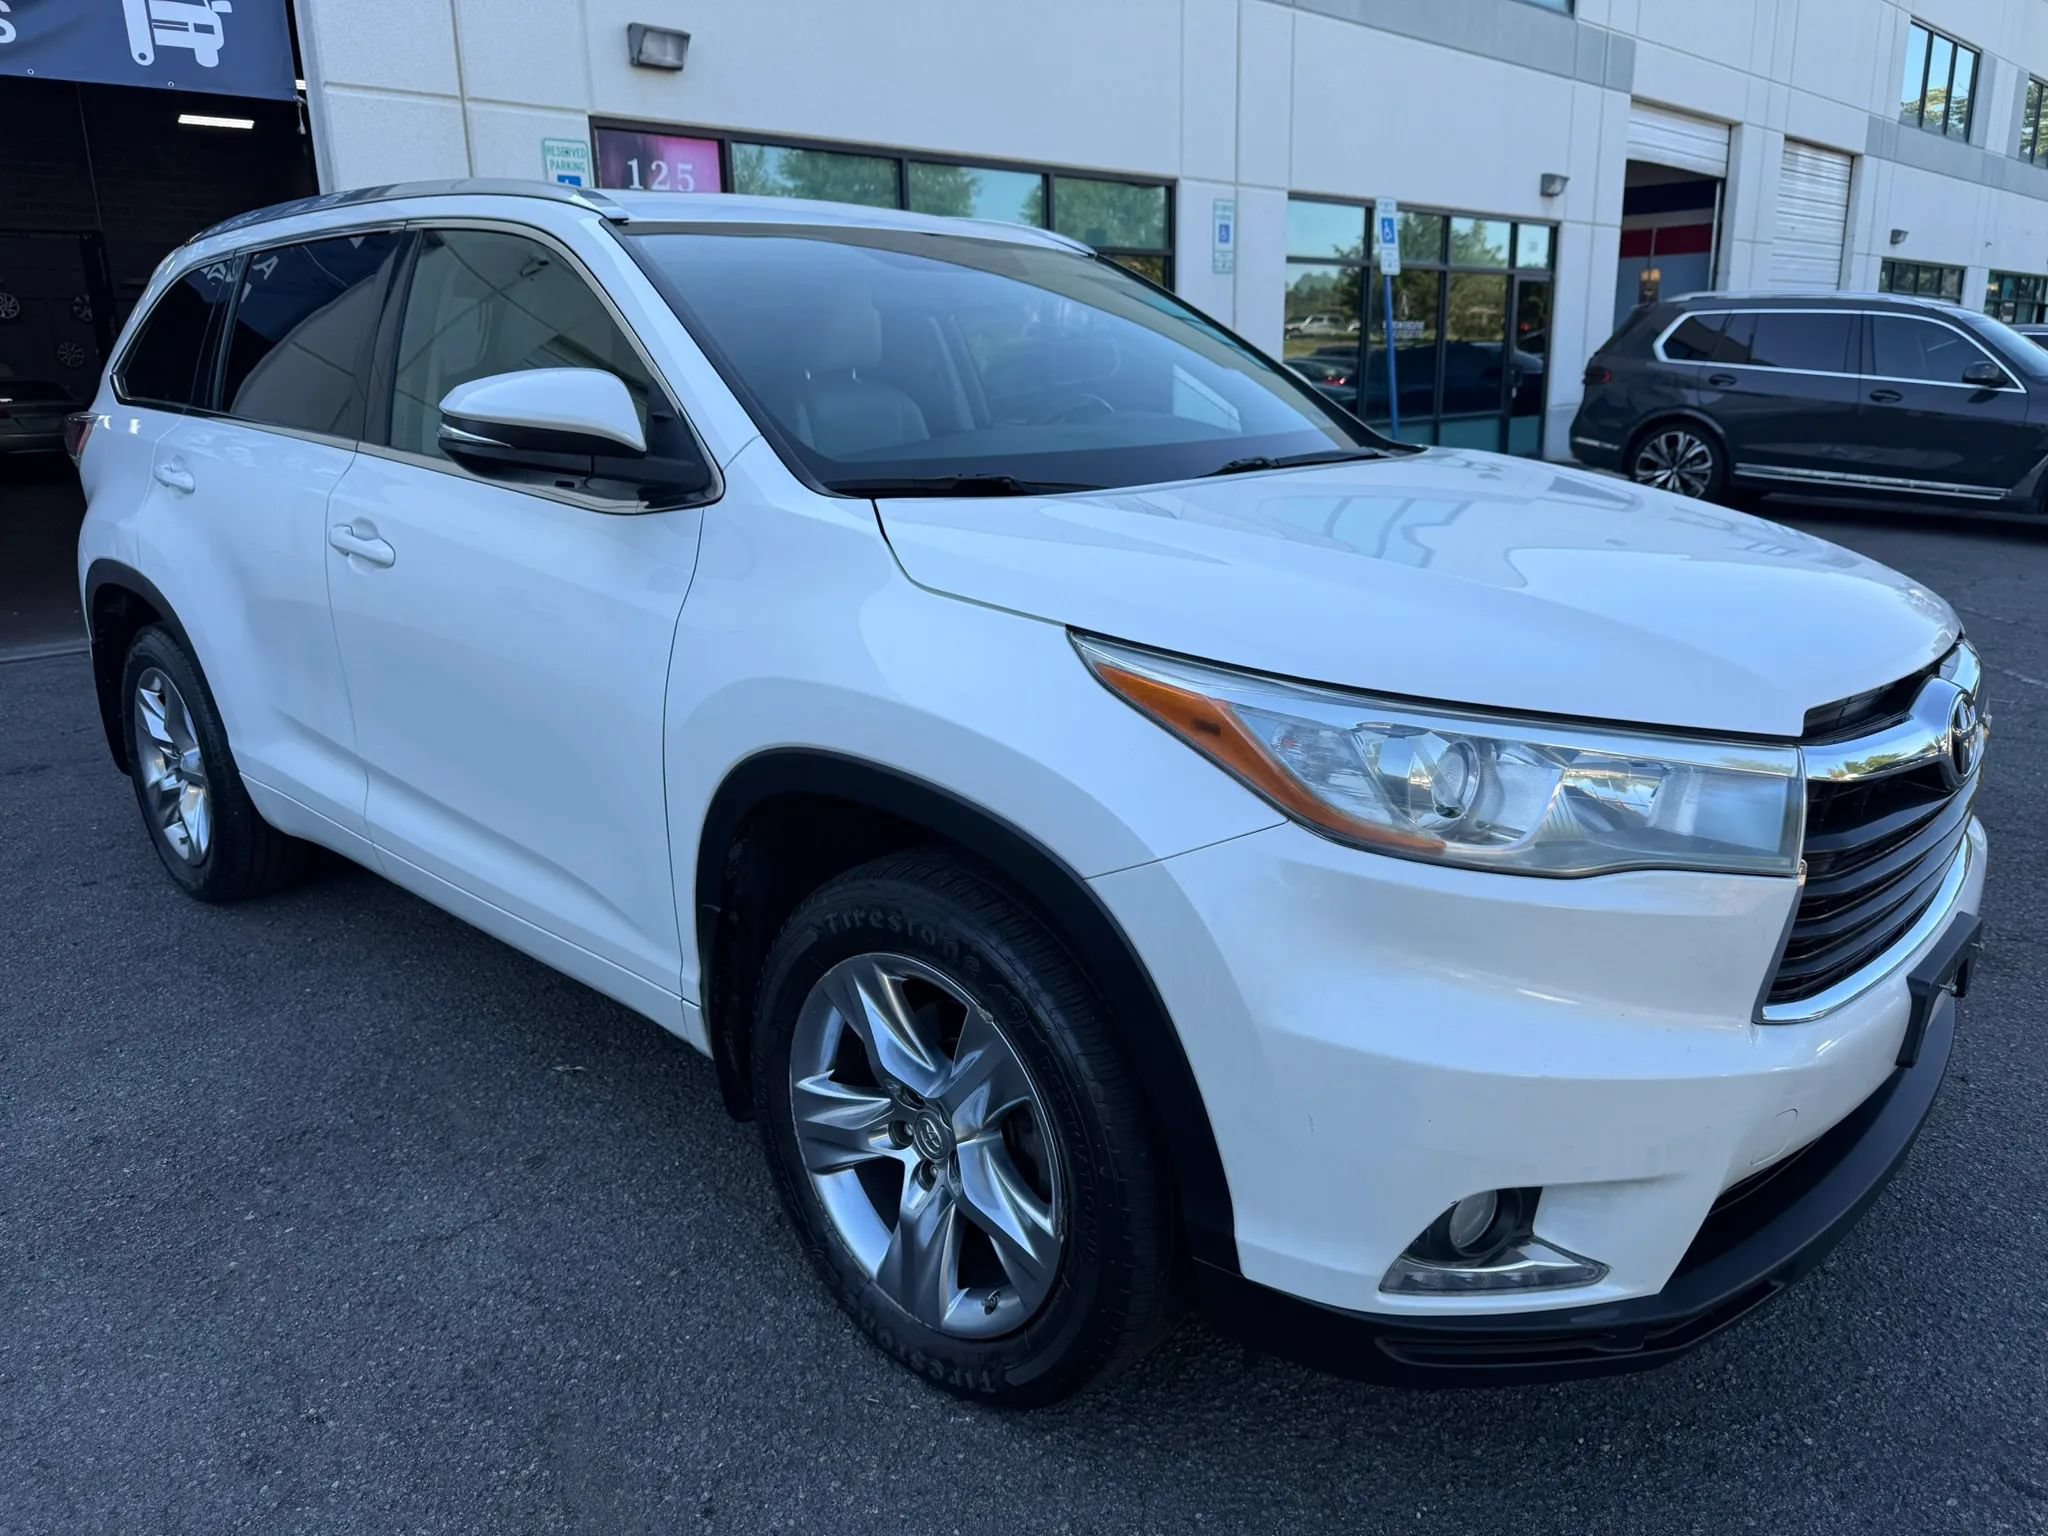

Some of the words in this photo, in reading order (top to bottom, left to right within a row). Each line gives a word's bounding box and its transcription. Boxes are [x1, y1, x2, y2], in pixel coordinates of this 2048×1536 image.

[545, 145, 586, 159] RESERVED
[549, 159, 586, 173] PARKING
[626, 157, 695, 192] 125
[824, 908, 981, 977] Firestone
